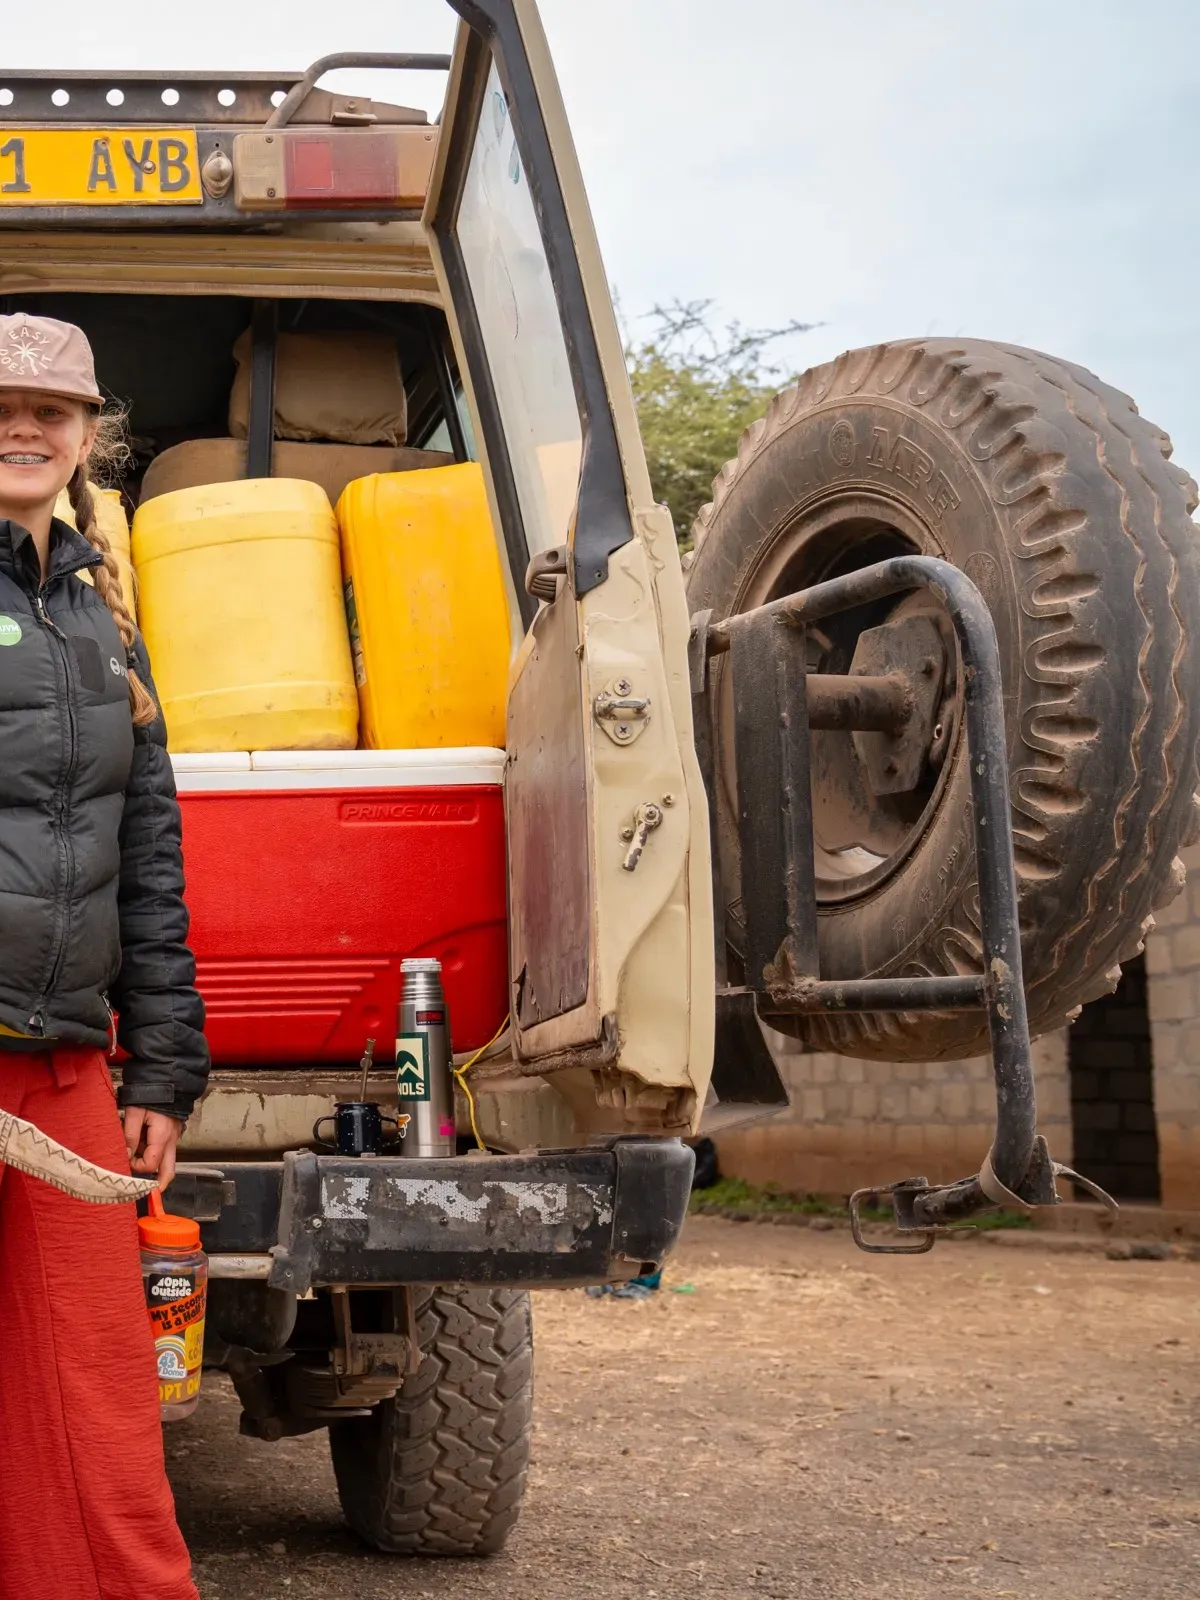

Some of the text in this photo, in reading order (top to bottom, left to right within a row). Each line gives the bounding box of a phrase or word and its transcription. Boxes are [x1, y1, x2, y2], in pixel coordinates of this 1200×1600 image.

[87, 137, 191, 193] AYB
[8, 326, 51, 346] EASY
[39, 354, 53, 371] IT
[397, 1082, 425, 1096] NOLS
[164, 1276, 183, 1288] Opt
[151, 1285, 192, 1297] Outside
[150, 1310, 169, 1322] My
[161, 1320, 173, 1331] is
[174, 1316, 183, 1326] a
[162, 1367, 184, 1377] Dome
